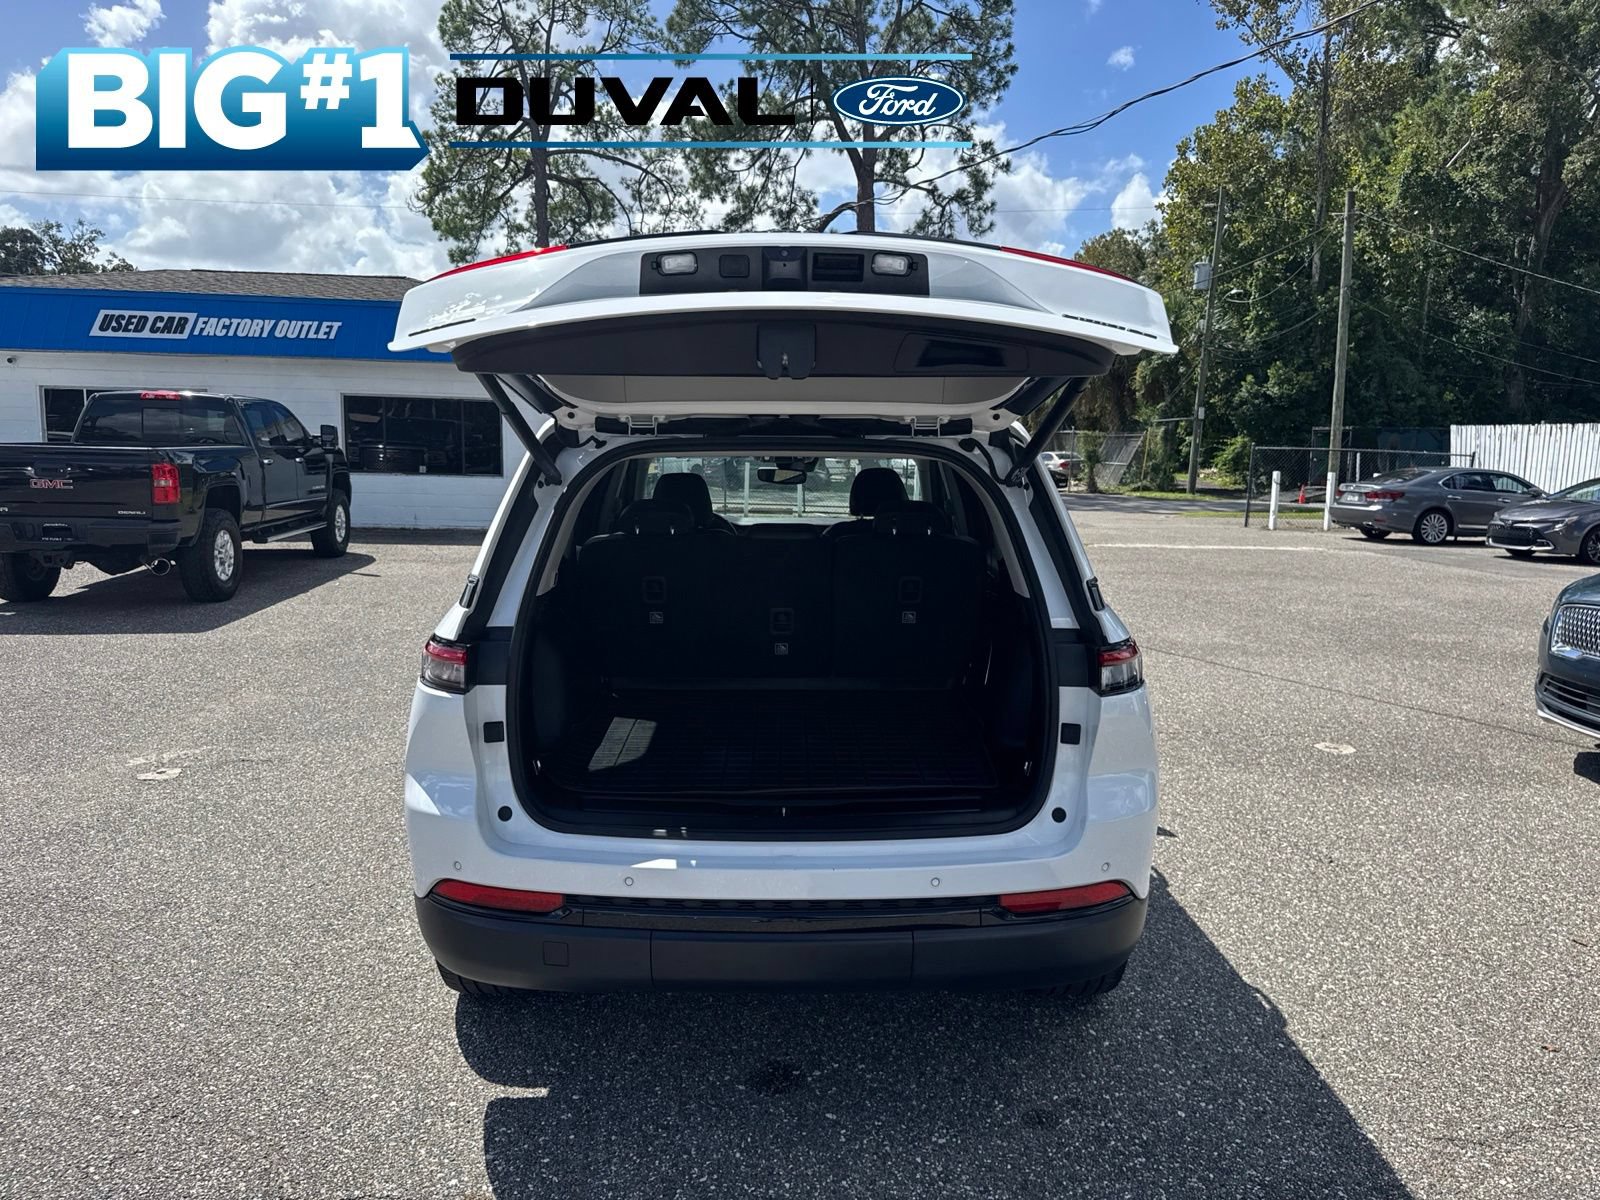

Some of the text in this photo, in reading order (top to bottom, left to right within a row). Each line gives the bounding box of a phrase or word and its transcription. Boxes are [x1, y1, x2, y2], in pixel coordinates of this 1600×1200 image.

[99, 313, 342, 340] USED CAR FACTORY OUTLET
[30, 479, 74, 489] GMC
